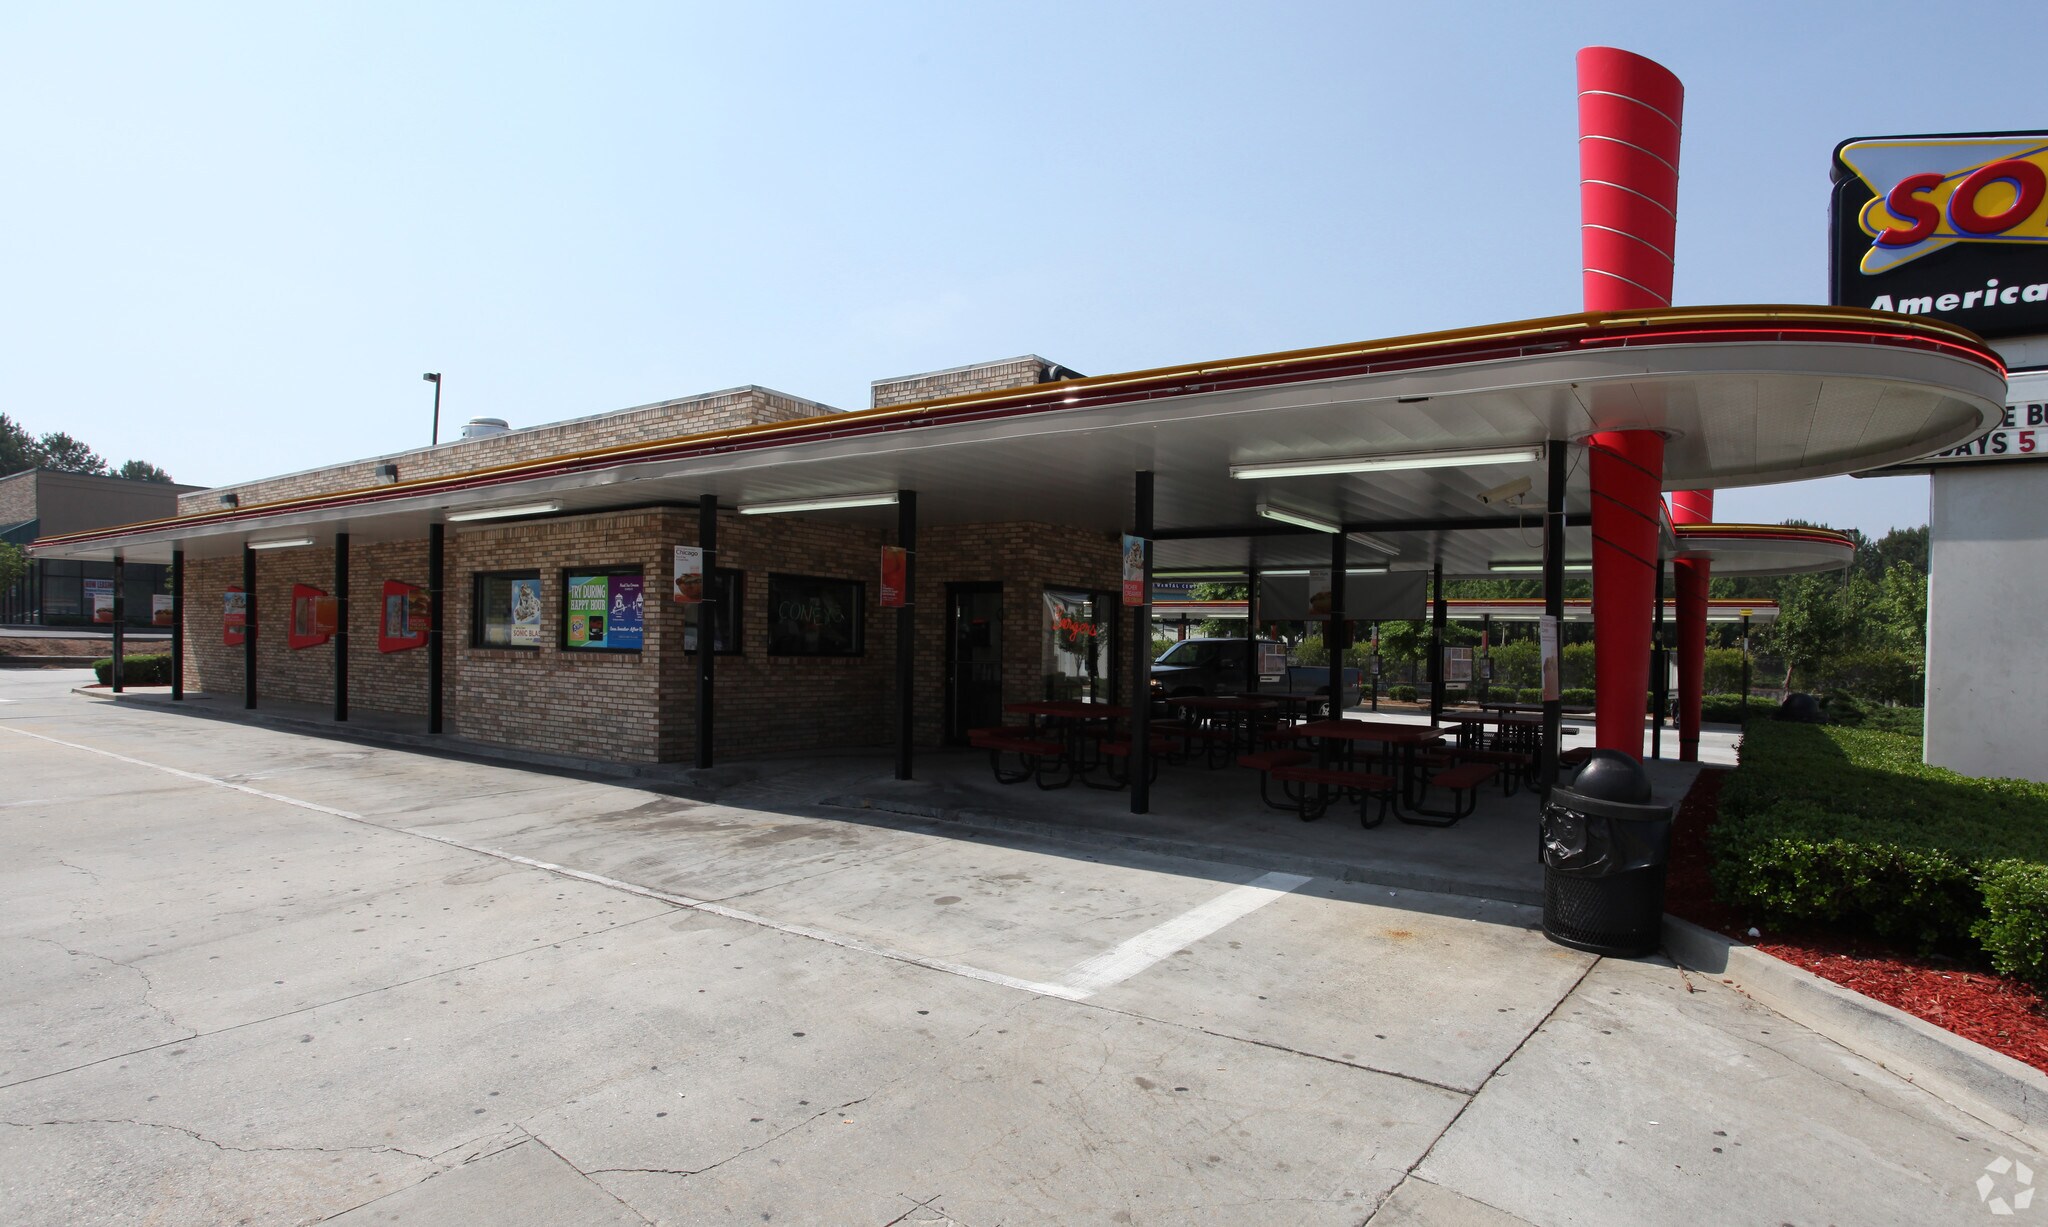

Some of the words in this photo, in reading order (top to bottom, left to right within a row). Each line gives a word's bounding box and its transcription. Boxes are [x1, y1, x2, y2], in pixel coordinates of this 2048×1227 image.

[1873, 159, 2048, 249] SO
[2027, 404, 2048, 426] B
[1939, 432, 2007, 457] AYS
[2019, 430, 2036, 453] 5
[571, 585, 583, 599] TRY
[583, 585, 605, 599] DURING
[571, 600, 590, 611] HAPPY
[590, 600, 606, 611] HOUR
